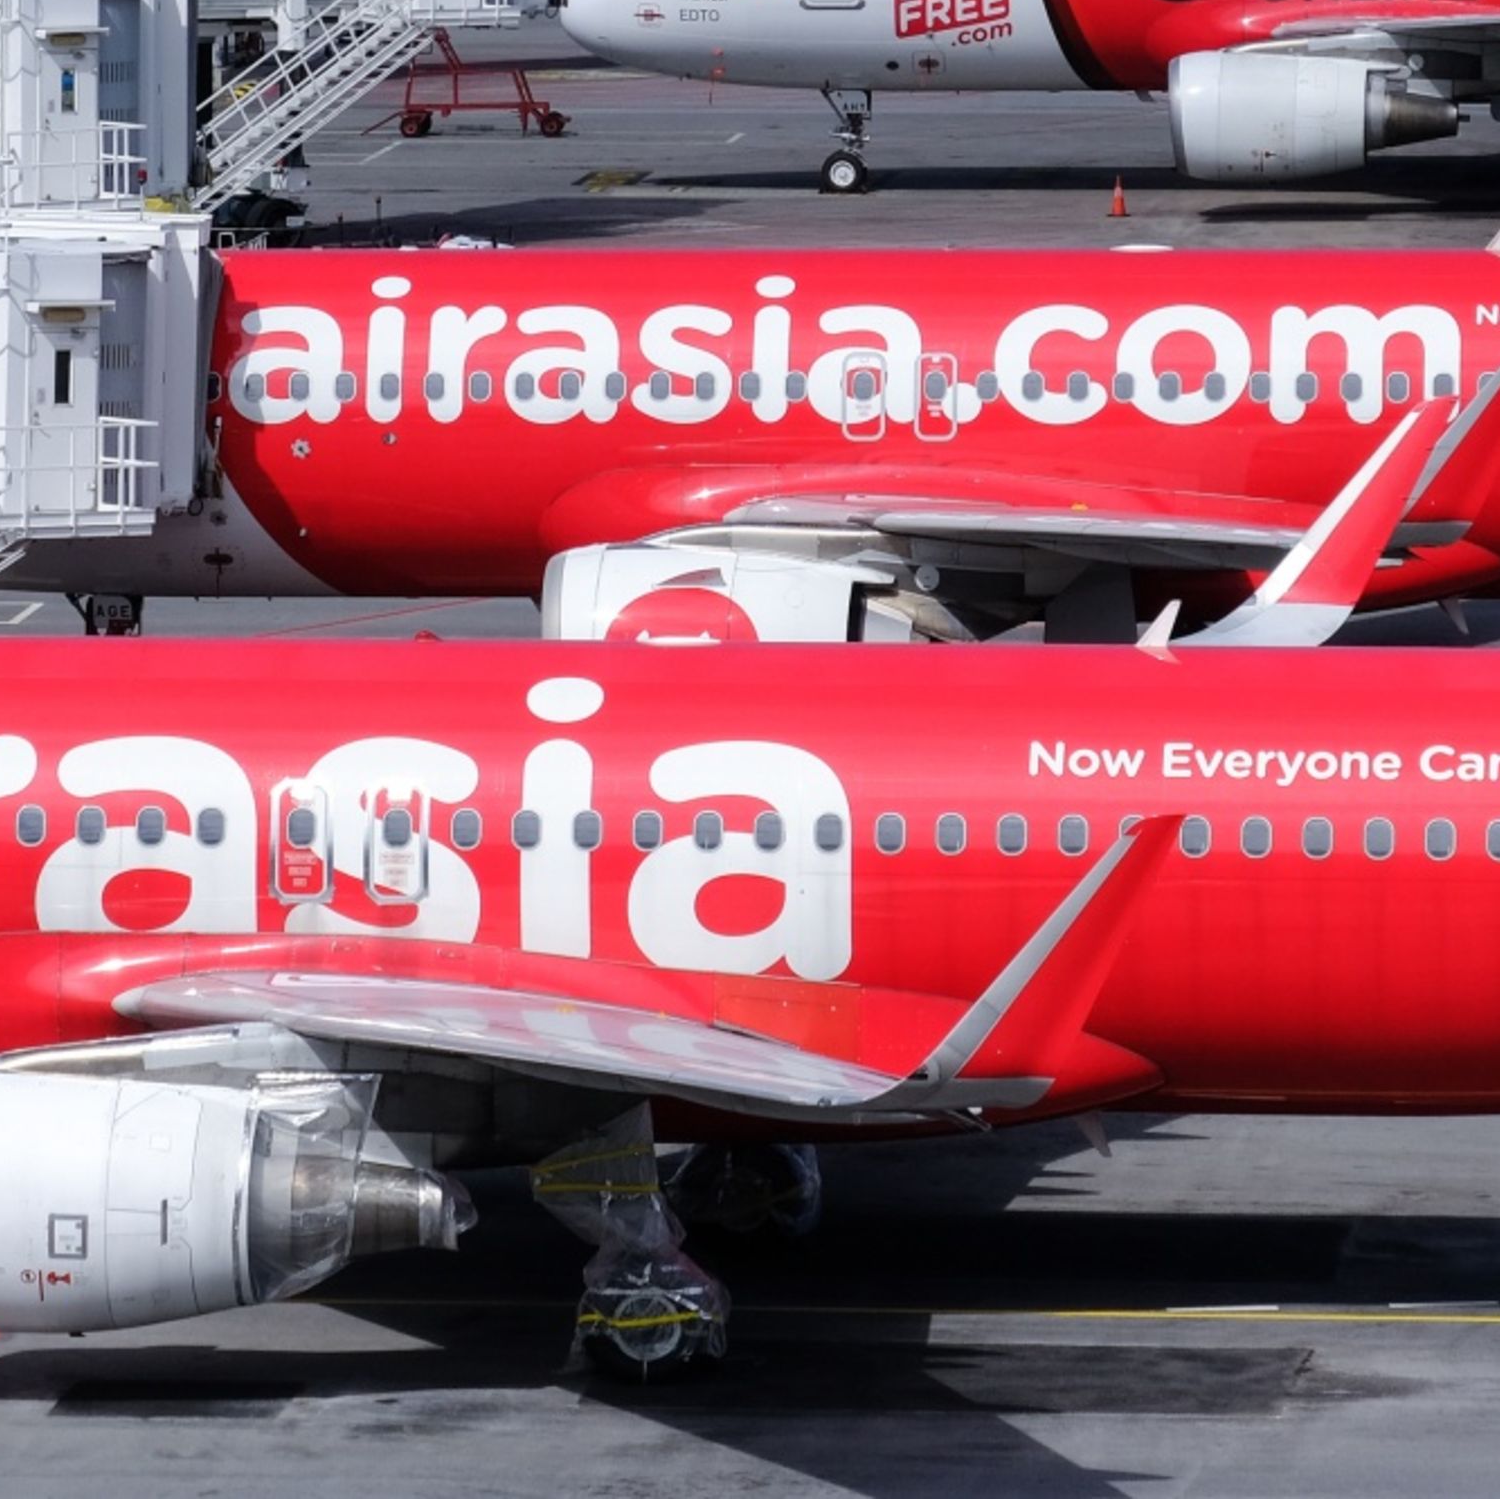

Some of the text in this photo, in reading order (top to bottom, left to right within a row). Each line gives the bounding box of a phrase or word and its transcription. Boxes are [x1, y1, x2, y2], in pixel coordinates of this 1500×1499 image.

[680, 9, 720, 22] EDTO
[951, 22, 1013, 47] .com
[227, 275, 1462, 425] airasia.com
[1028, 741, 1145, 780] Now
[1161, 741, 1403, 787] Everyone
